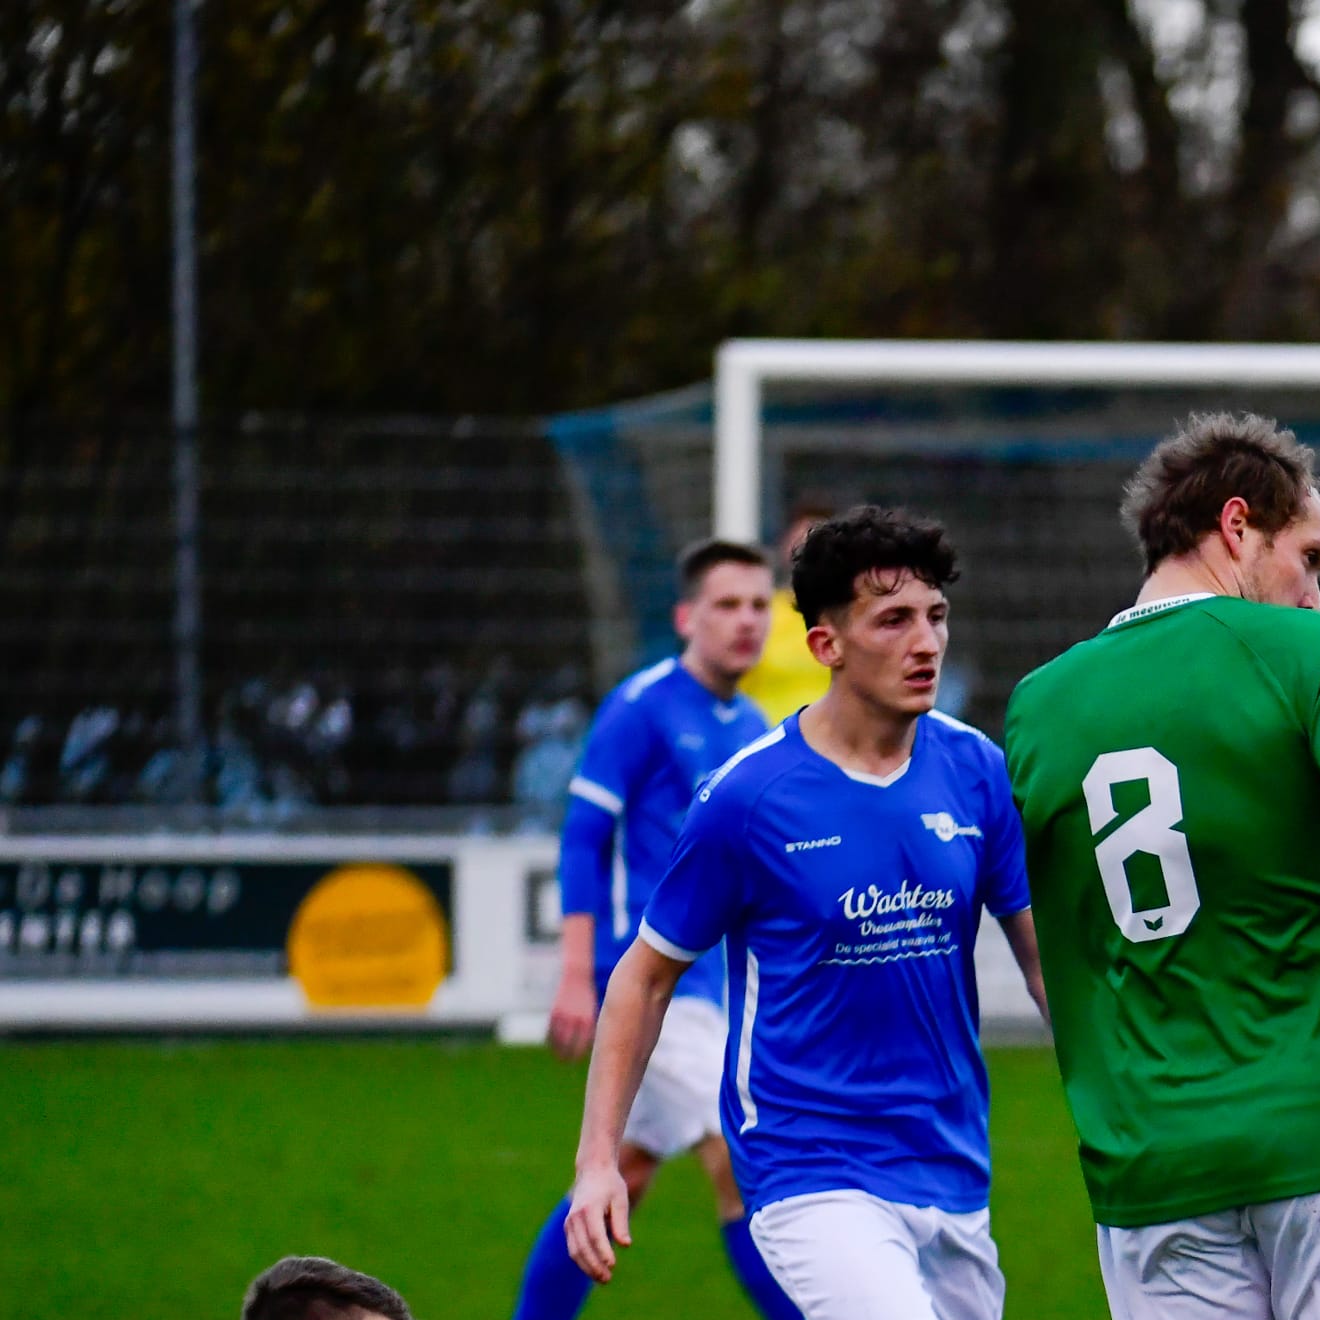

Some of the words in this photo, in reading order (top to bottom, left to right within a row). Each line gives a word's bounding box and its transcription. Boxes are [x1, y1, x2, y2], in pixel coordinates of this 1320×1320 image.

[785, 835, 842, 853] STANNO
[1082, 746, 1200, 943] 8
[838, 879, 956, 920] Wachters
